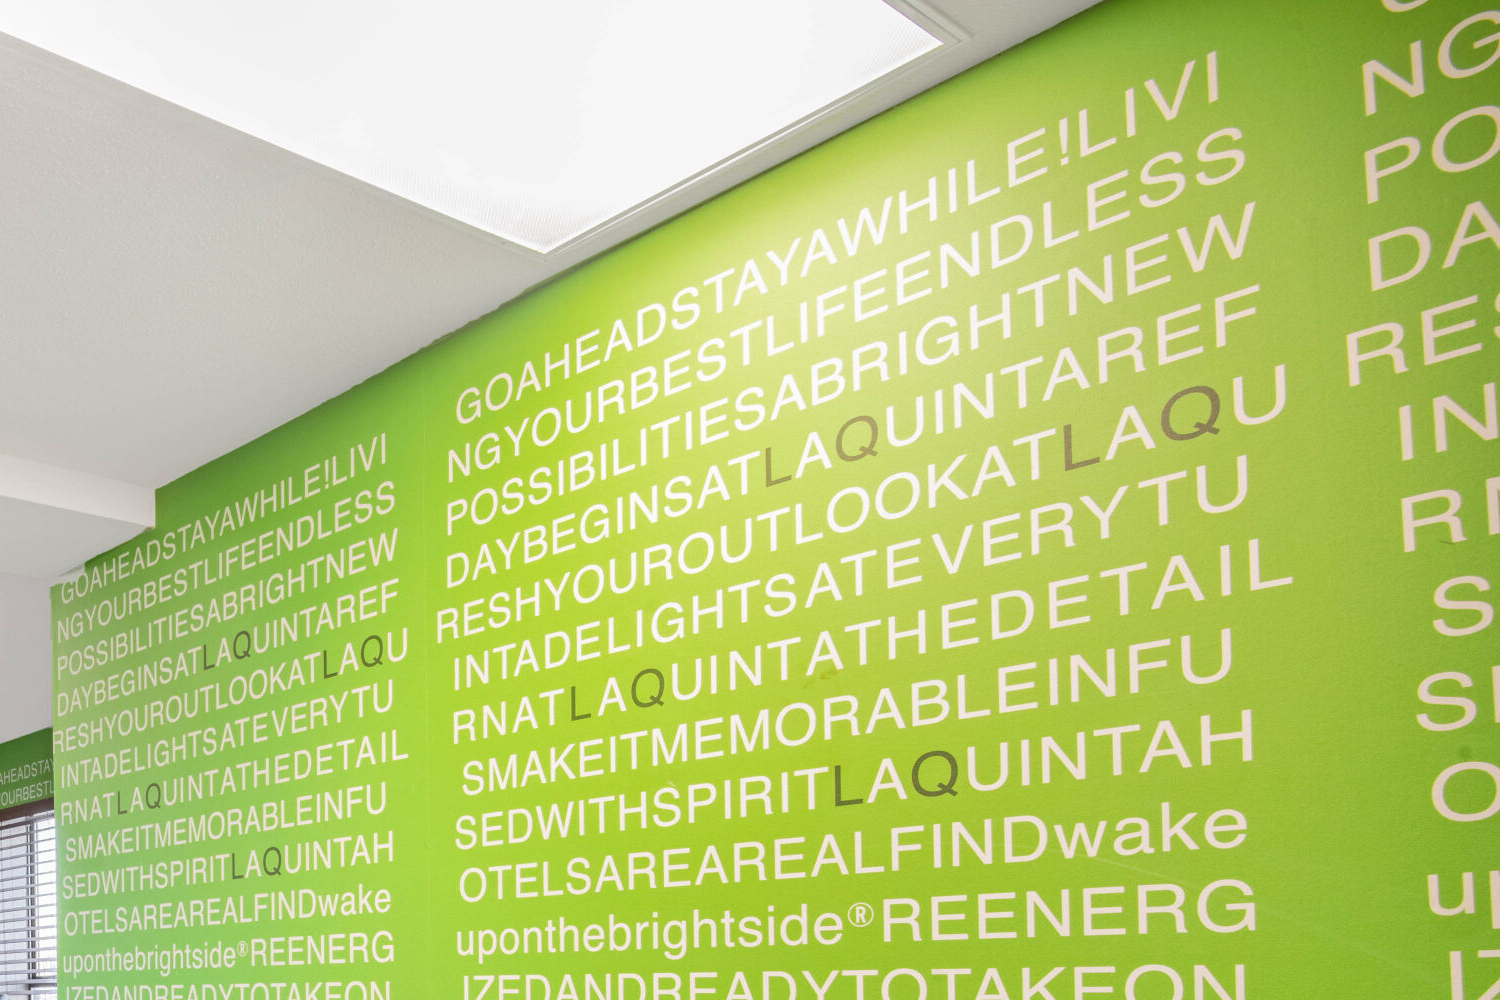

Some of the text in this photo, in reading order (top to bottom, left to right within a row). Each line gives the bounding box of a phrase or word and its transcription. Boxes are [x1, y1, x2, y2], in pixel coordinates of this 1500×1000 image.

[448, 127, 1247, 482] NGYOURBESTLIFEENDLESS
[456, 50, 1220, 424] GOAHEADSTAYAWHILE!LIVI
[446, 284, 1261, 588] DAYBEGINSATLAQUINTAREF
[447, 201, 1257, 535] POSSIBILITIESABRIGHTNEW
[57, 481, 395, 644] NGYOURBESTLIFEENDLESS
[61, 433, 387, 604] GOAHEADSTAYAWHILE!LIVI
[436, 364, 1287, 643] RESHYOUROUTLOOKATLAQU
[454, 454, 1249, 691] INTADELIGHTSATEVERYTU
[57, 528, 398, 680] POSSIBILITIESABRIGHTNEW
[57, 578, 400, 717] DAYBEGINSATLAQUINTAREF
[453, 539, 1294, 745] RNATLAQUINTATHEDETAIL
[52, 628, 408, 755] RESHYOUROUTLOOKATLAQU
[61, 680, 393, 789] INTADELIGHTSATEVERYTU
[462, 628, 1233, 795] SMAKEITMEMORABLEINFU
[60, 730, 409, 826] RNATLAQUINTATHEDETAIL
[65, 782, 387, 862] SMAKEITMEMORABLEINFU
[456, 710, 1254, 850] SEDWITHSPIRITLAQUINTAH
[459, 802, 1248, 903] OTELSAREAREALFINDwake
[62, 831, 394, 900] SEDWITHSPIRITLAQUINTAH
[64, 884, 391, 936] OTELSAREAREALFINDwake
